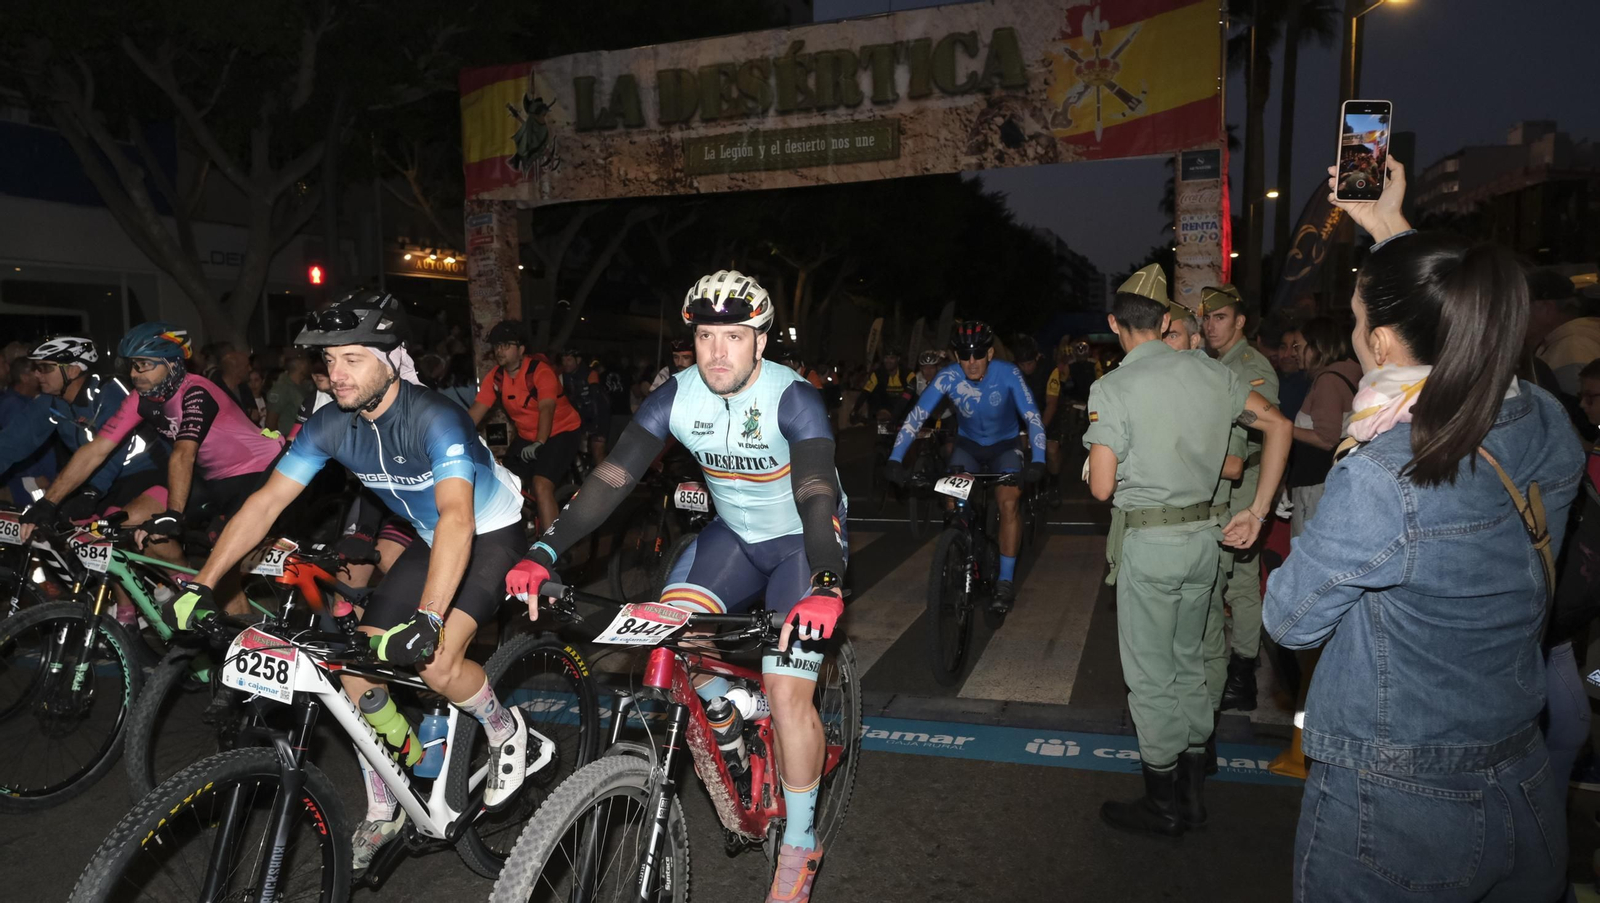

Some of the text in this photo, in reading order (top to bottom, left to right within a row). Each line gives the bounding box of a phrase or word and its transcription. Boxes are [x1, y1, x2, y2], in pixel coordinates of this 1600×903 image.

[573, 26, 1029, 132] LA DESÉRTICA
[704, 134, 875, 161] La Legión y el desierto nos une
[1181, 221, 1219, 232] RENTA
[745, 442, 770, 450] EDICIÓN
[704, 450, 779, 471] DESÉRTICA
[679, 490, 705, 505] 8550
[616, 617, 676, 636] 8447
[235, 648, 290, 685] 6258
[247, 681, 279, 695] cajamar
[922, 742, 966, 751] RURAL
